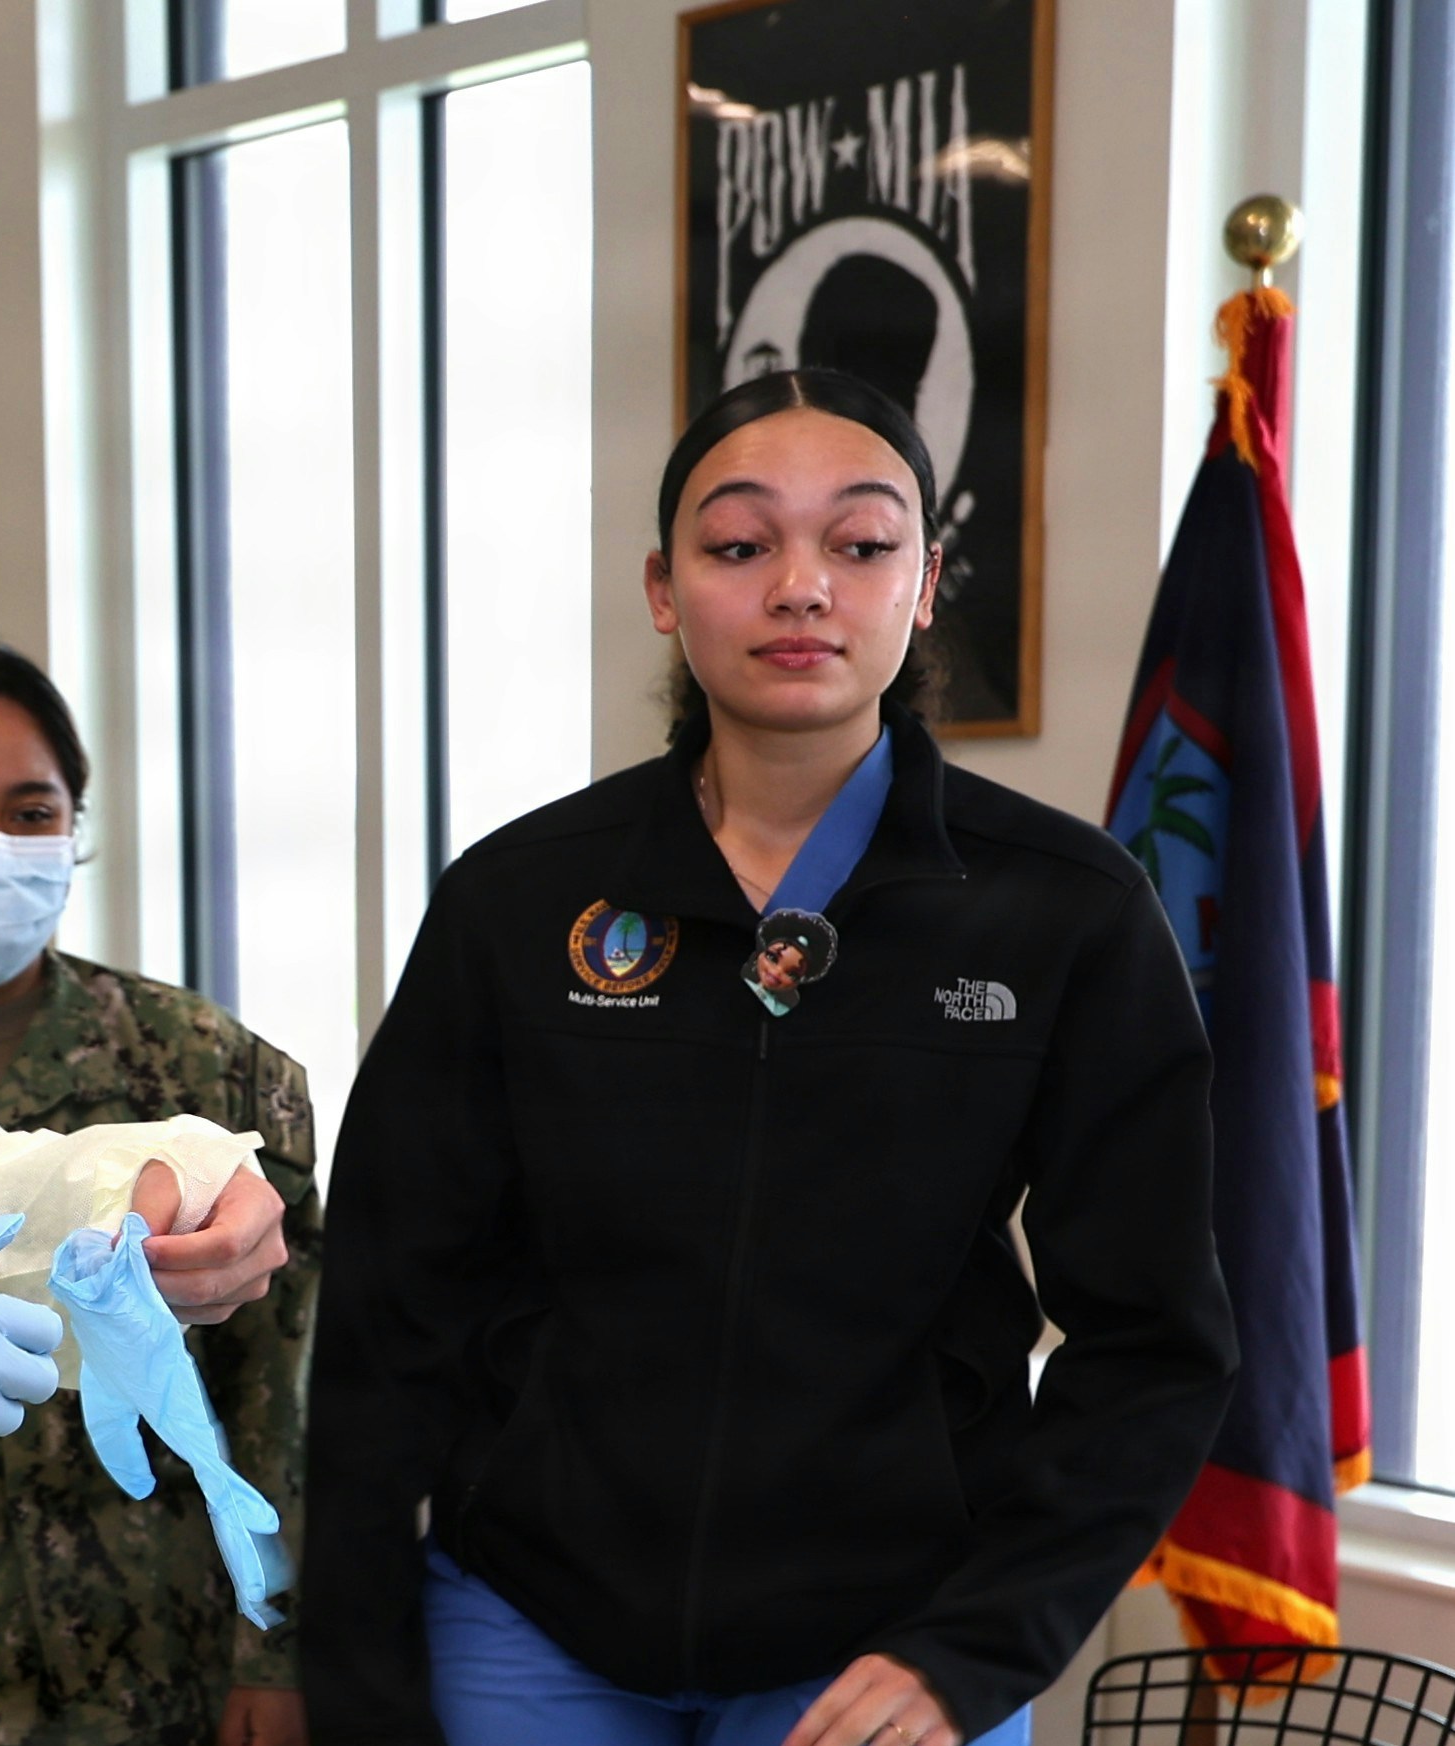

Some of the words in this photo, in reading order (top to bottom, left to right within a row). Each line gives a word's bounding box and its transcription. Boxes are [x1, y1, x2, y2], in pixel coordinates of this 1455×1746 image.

[715, 97, 837, 352] POW
[866, 62, 978, 292] MIA
[956, 977, 986, 995] THE
[568, 990, 637, 1008] Multi-Service
[638, 995, 660, 1007] Unit
[933, 986, 985, 1009] NORTH
[944, 1004, 984, 1021] FACE
